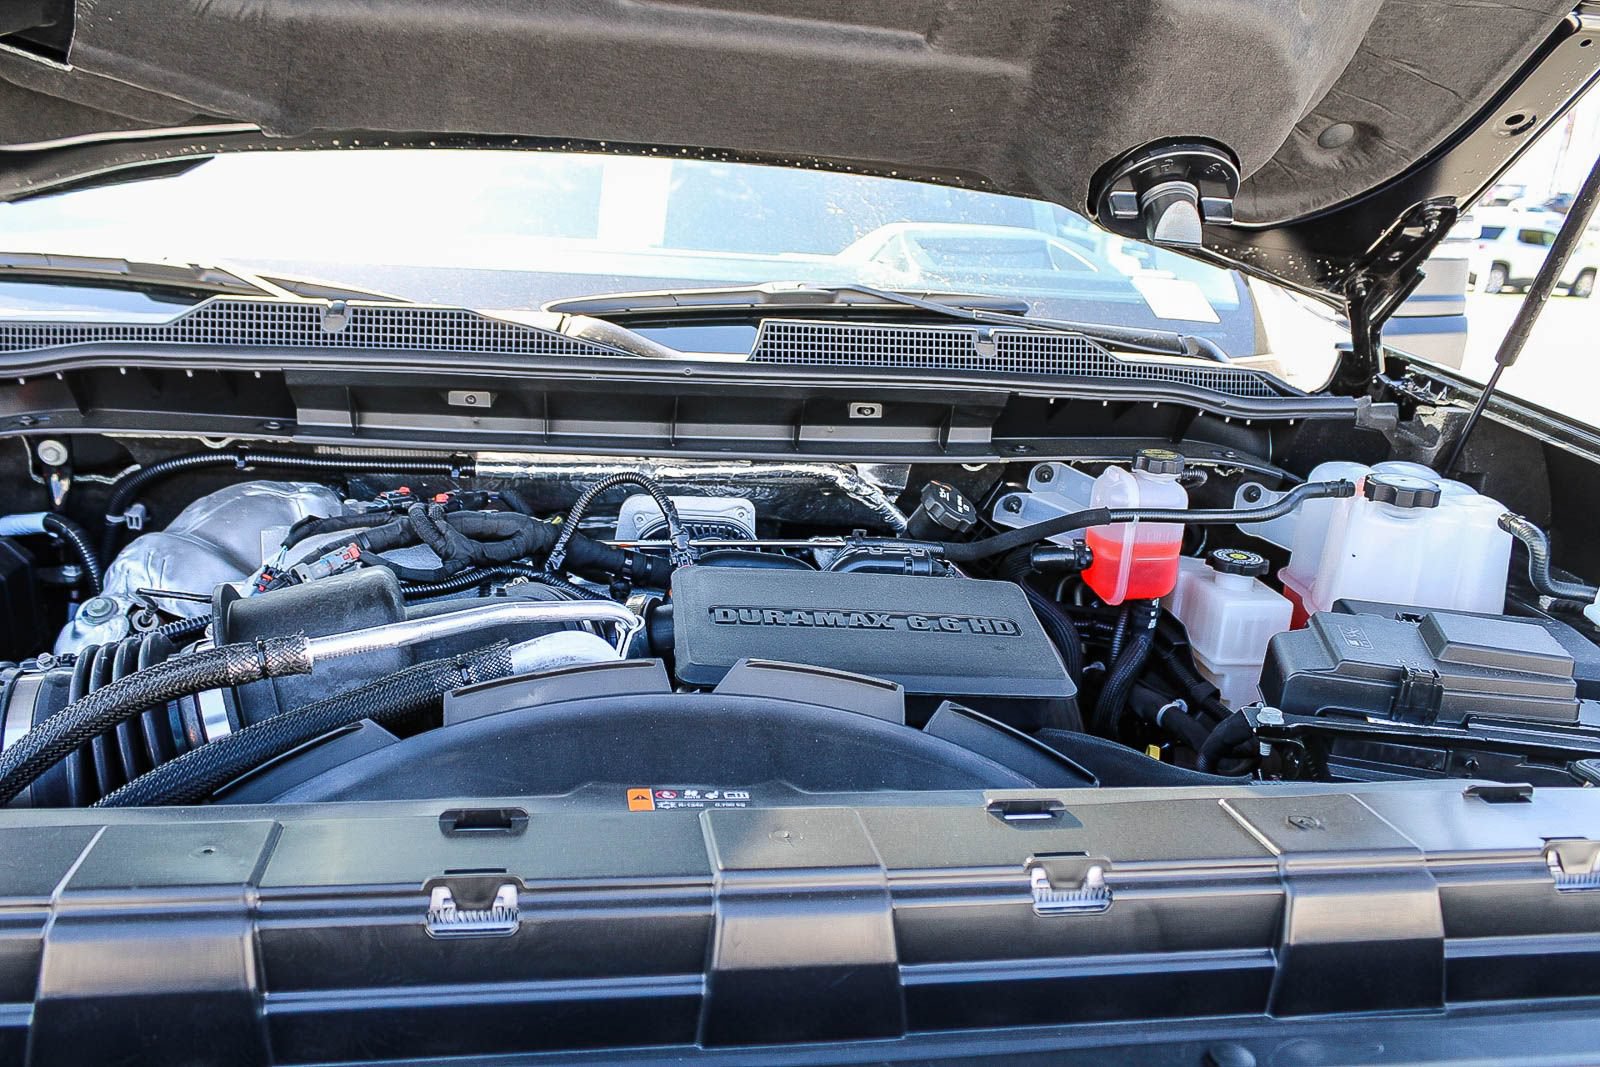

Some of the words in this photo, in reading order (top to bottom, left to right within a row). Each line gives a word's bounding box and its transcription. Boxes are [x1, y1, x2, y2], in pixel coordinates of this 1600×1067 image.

[713, 608, 894, 631] DURAMAX
[906, 615, 962, 633] 6.6
[968, 618, 1020, 636] HD
